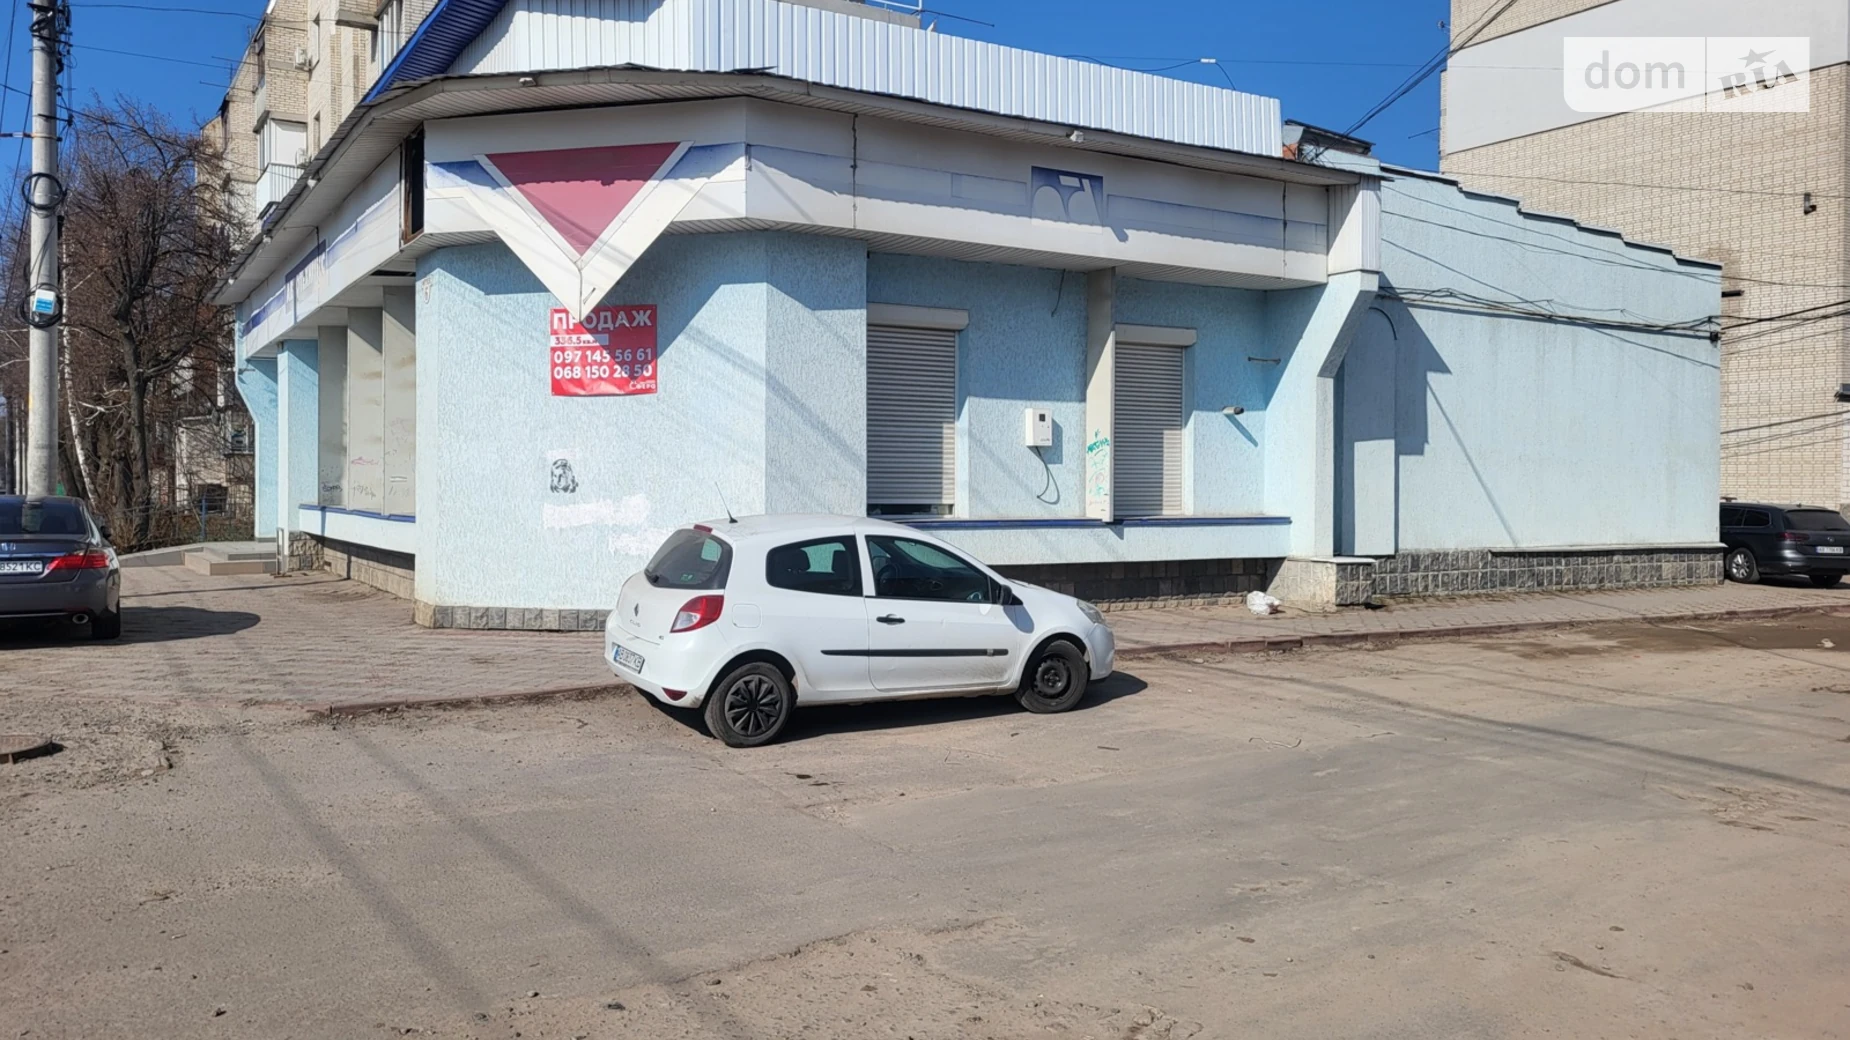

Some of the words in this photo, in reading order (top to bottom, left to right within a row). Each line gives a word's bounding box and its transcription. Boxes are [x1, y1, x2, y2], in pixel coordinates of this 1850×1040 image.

[554, 350, 582, 364] 097
[586, 349, 611, 363] 145
[615, 348, 632, 362] 56
[636, 347, 652, 361] 61
[553, 365, 581, 379] 068
[585, 365, 610, 379] 150
[613, 364, 630, 378] 28
[634, 363, 652, 377] 50
